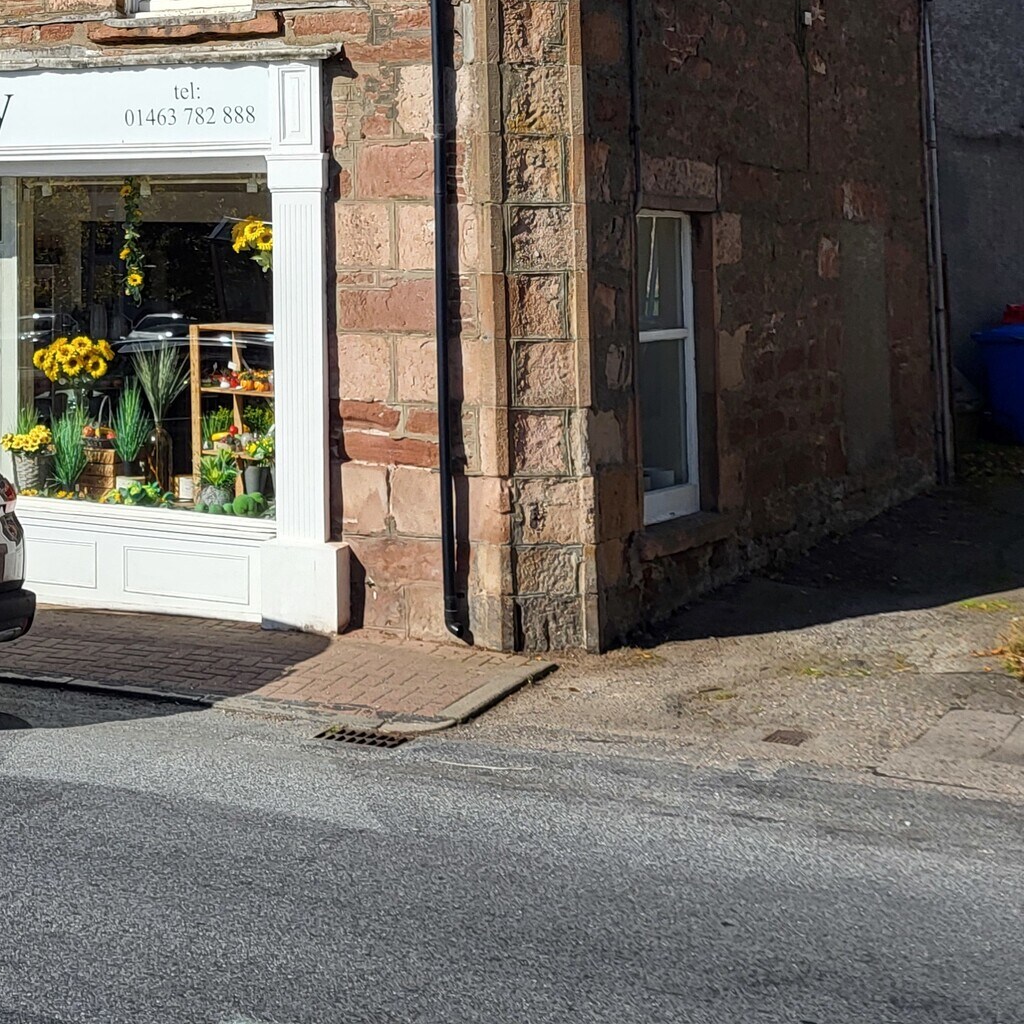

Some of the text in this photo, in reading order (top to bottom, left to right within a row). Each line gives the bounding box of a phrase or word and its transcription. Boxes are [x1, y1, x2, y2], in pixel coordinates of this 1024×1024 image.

[174, 81, 201, 100] tel:
[124, 104, 256, 127] 01463 782 888
